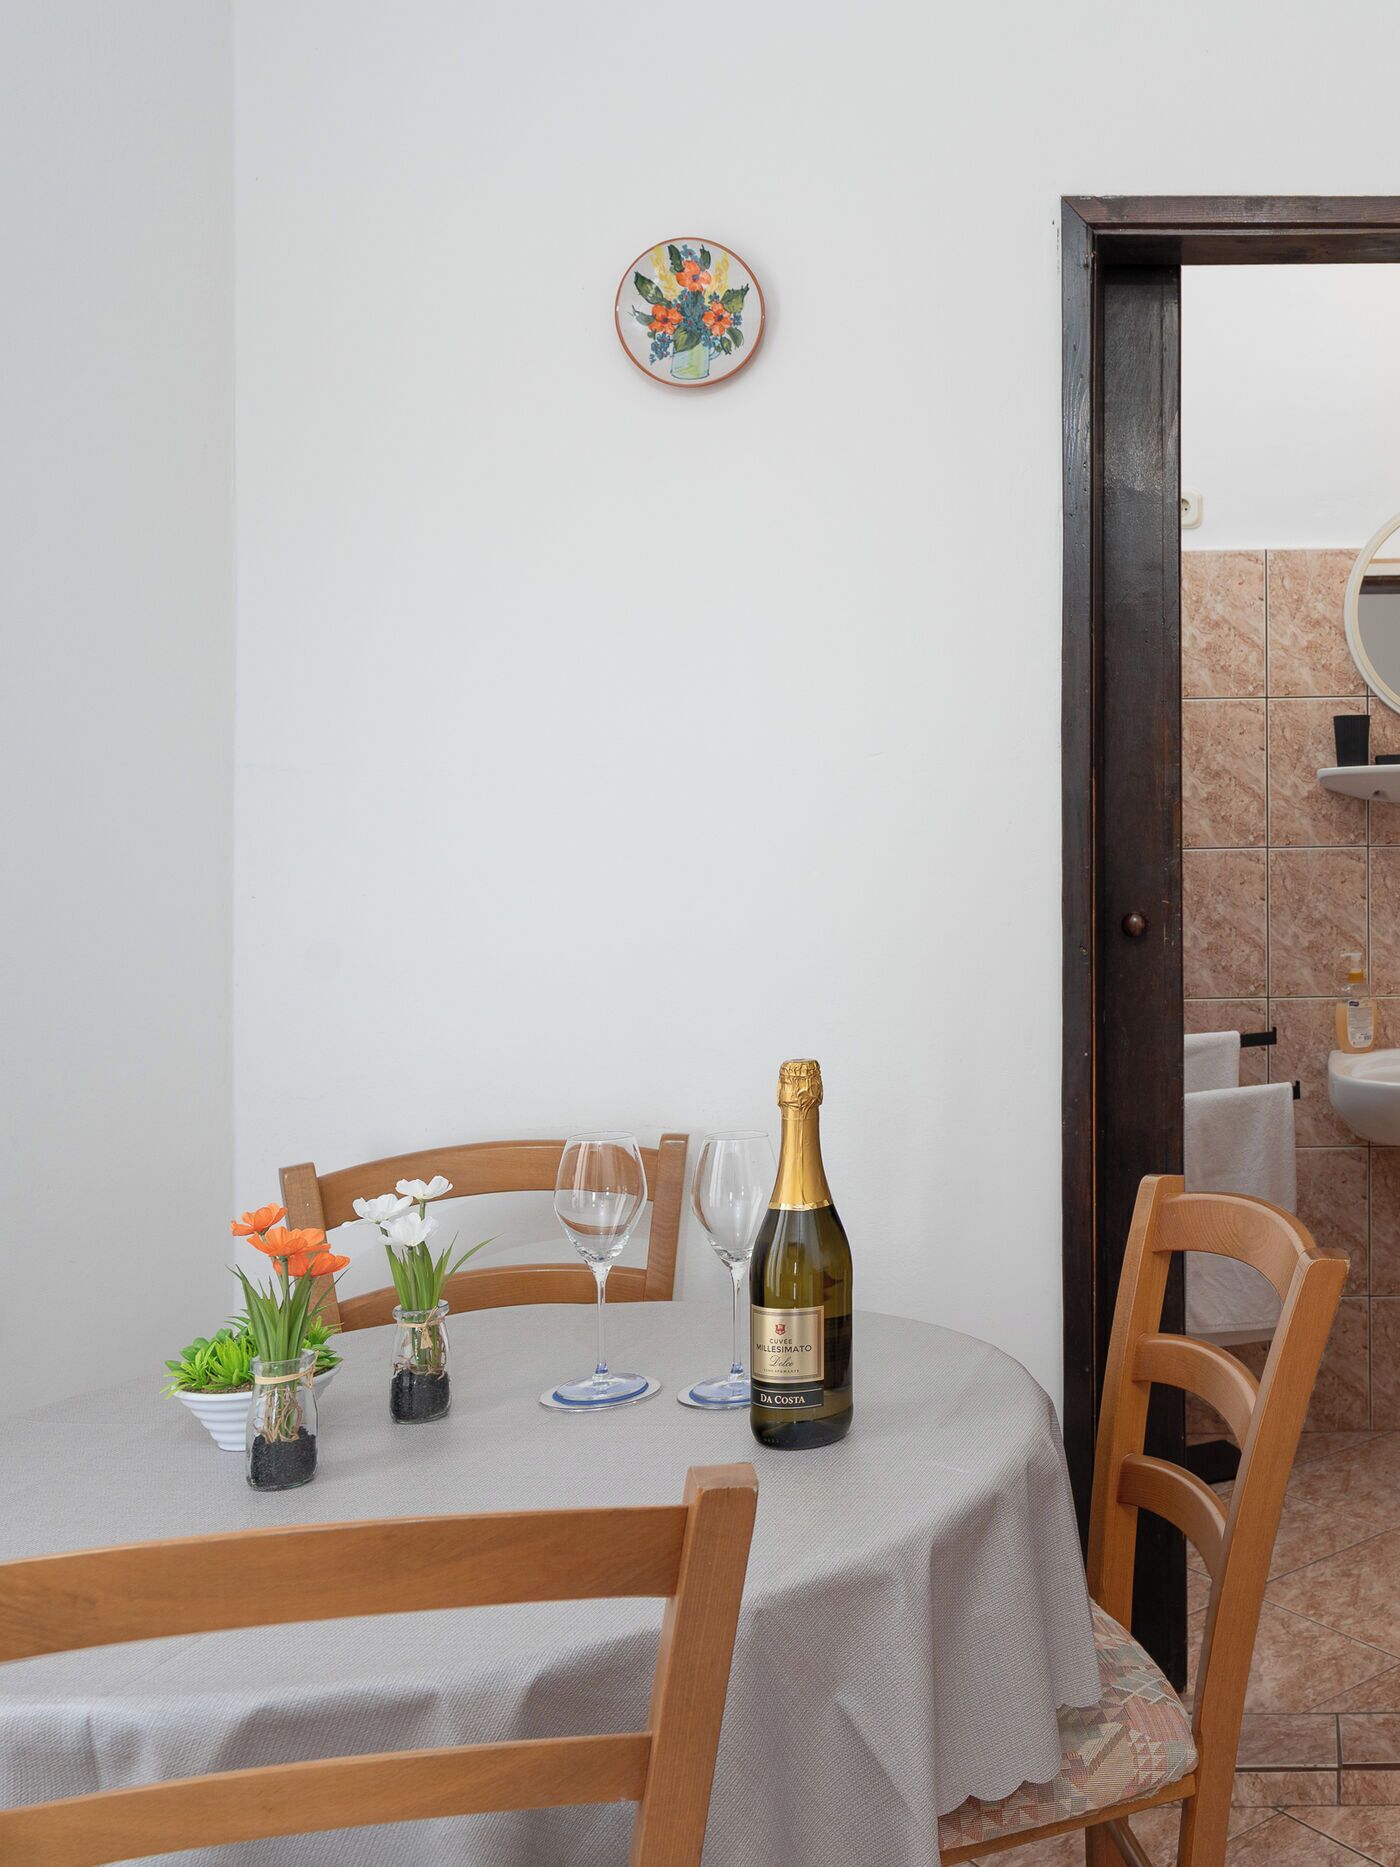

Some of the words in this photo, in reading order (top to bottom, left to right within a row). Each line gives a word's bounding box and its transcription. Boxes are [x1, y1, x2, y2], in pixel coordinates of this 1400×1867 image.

[756, 1344, 812, 1353] MILLESIMATO
[760, 1394, 773, 1404] DA
[774, 1396, 806, 1405] COSTA
